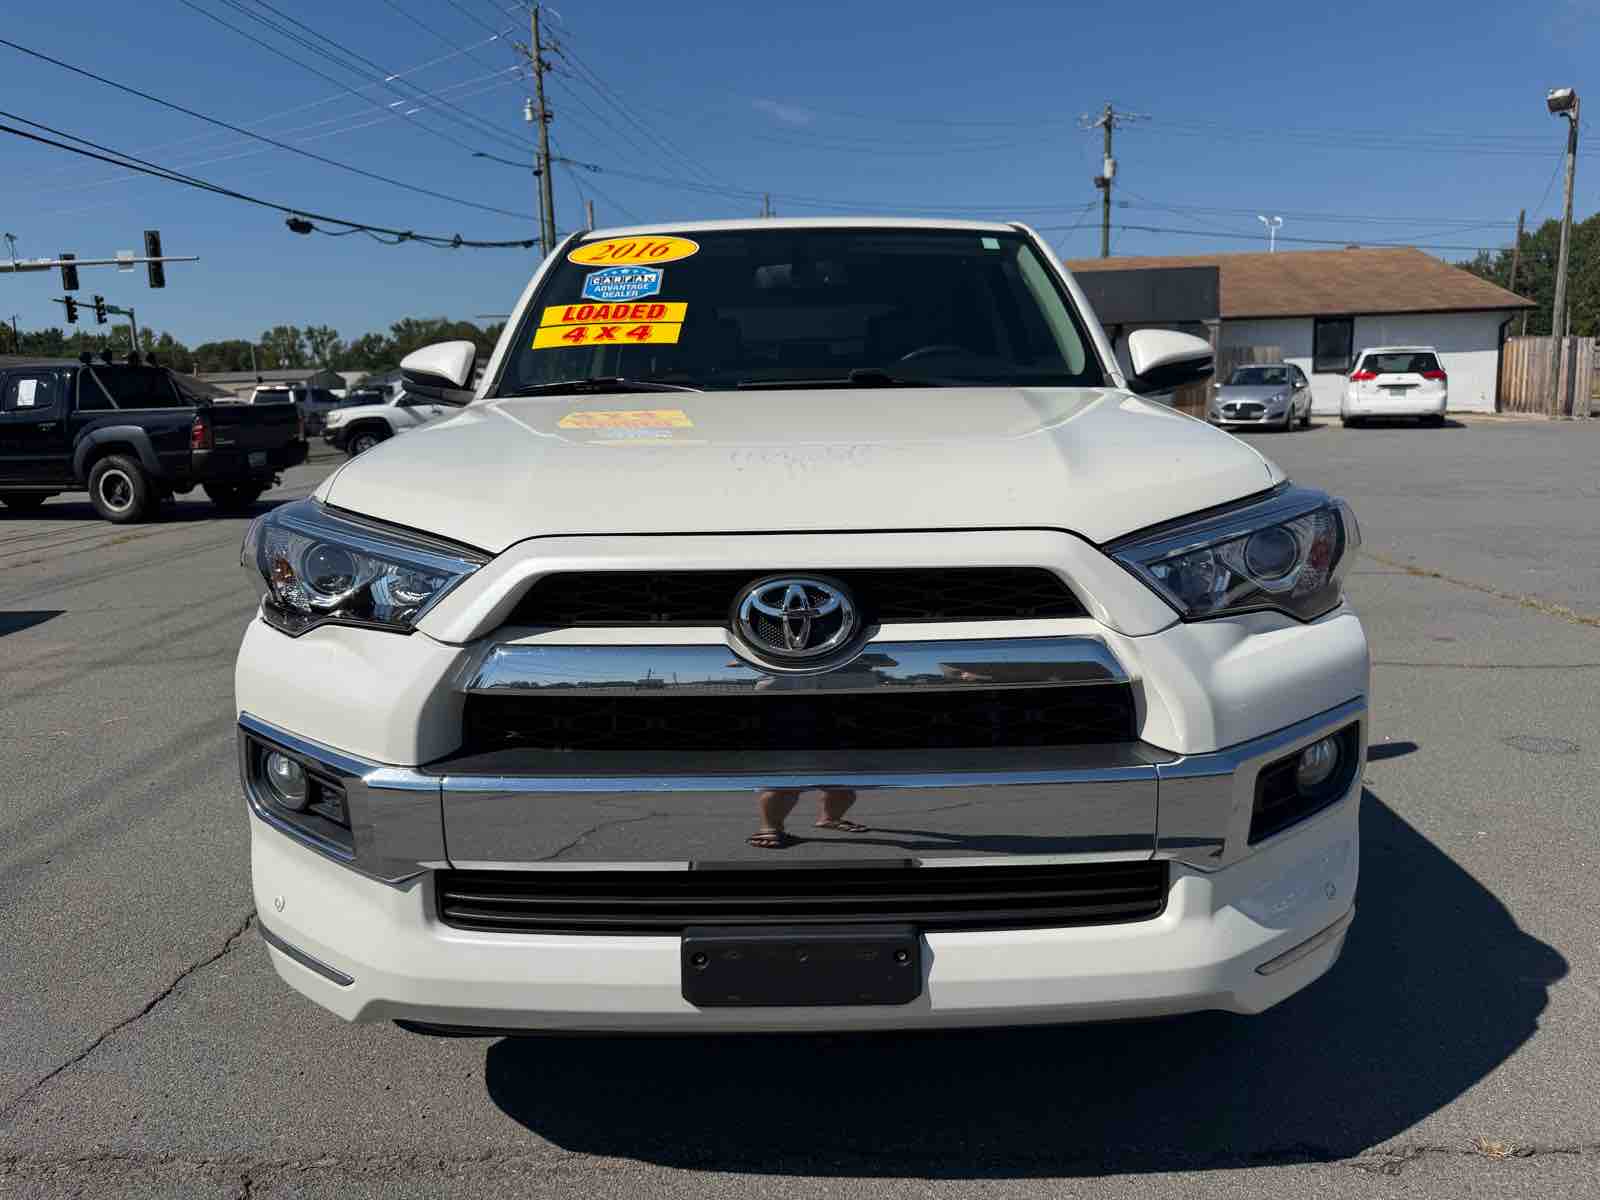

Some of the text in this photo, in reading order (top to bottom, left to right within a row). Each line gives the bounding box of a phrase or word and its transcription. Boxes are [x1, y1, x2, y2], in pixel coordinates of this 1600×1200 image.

[589, 241, 673, 260] 2016
[592, 275, 656, 285] CARFAX
[593, 283, 649, 292] ADVANTAGE
[562, 304, 666, 322] LOADED
